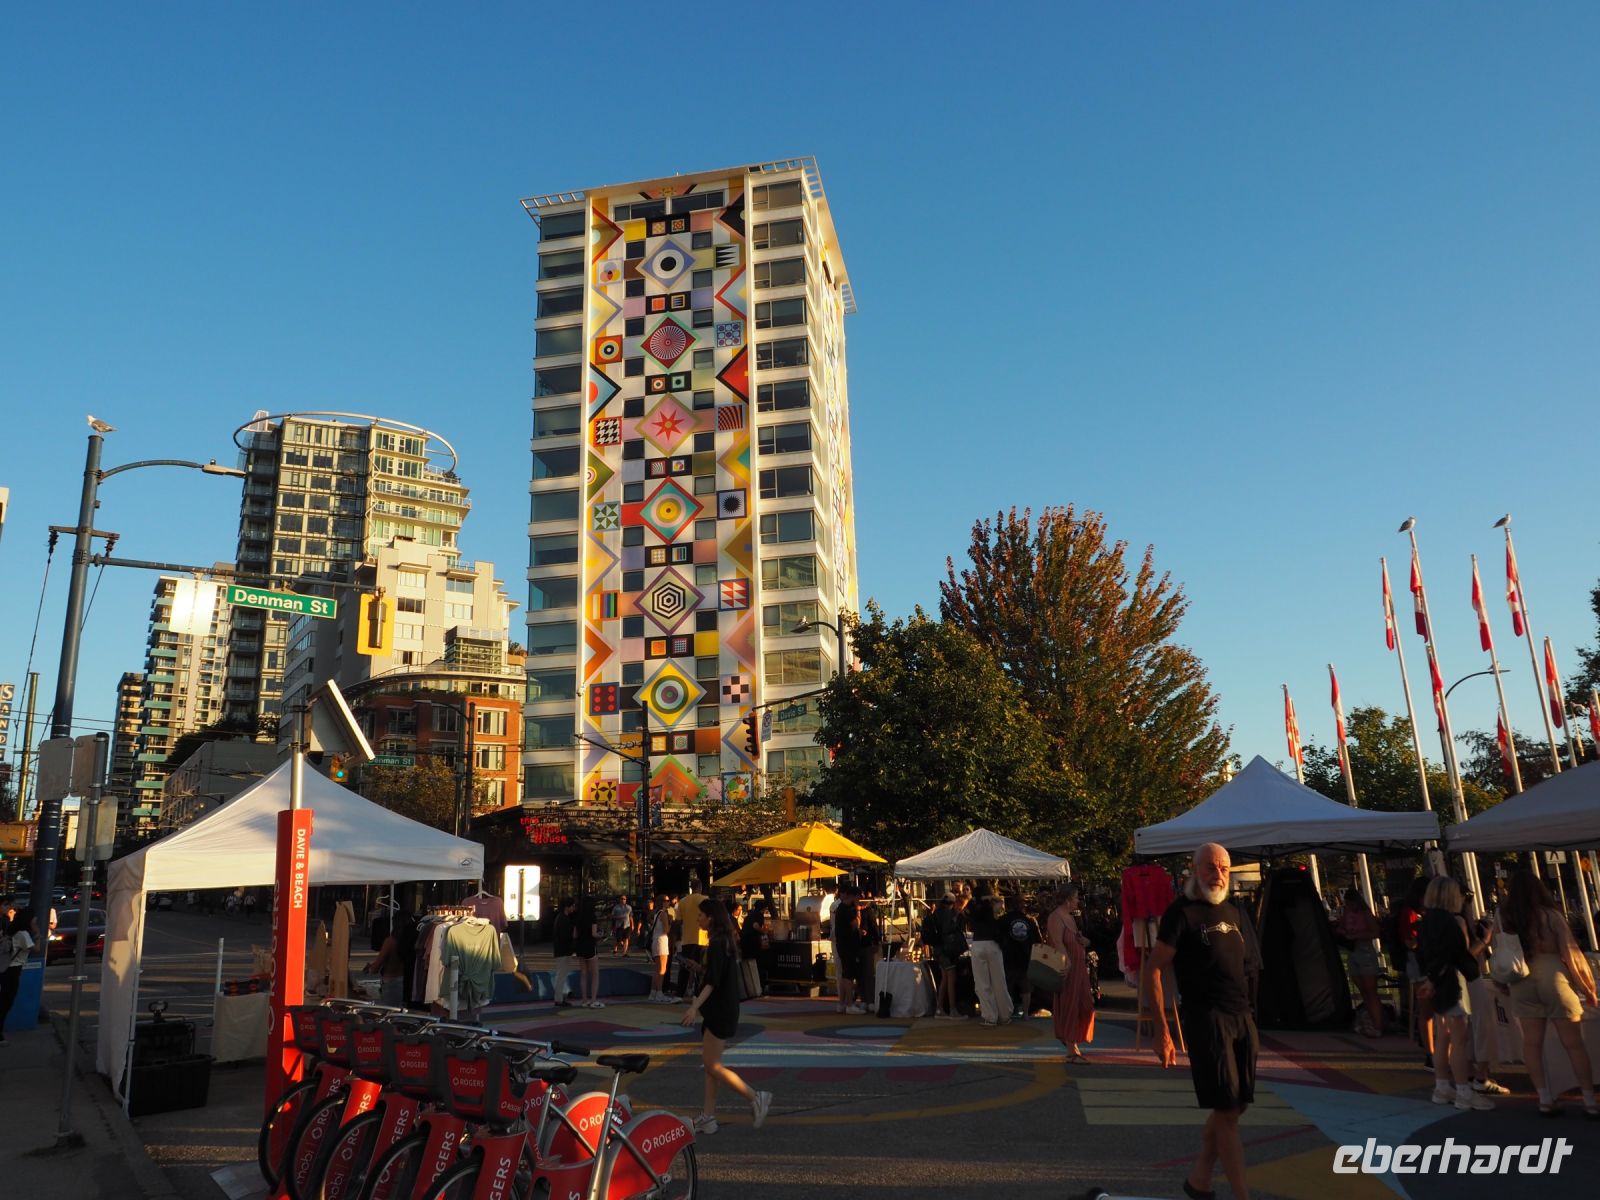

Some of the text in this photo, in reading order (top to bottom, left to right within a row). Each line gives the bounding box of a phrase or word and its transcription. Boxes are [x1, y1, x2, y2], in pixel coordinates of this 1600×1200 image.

[235, 588, 328, 614] Denman St
[534, 834, 568, 845] House
[294, 828, 306, 909] DAVIE & BEACH
[406, 1060, 428, 1069] ROGERS
[459, 1066, 477, 1075] mobi
[459, 1077, 485, 1088] ROGERS
[652, 1125, 686, 1149] ROGERS
